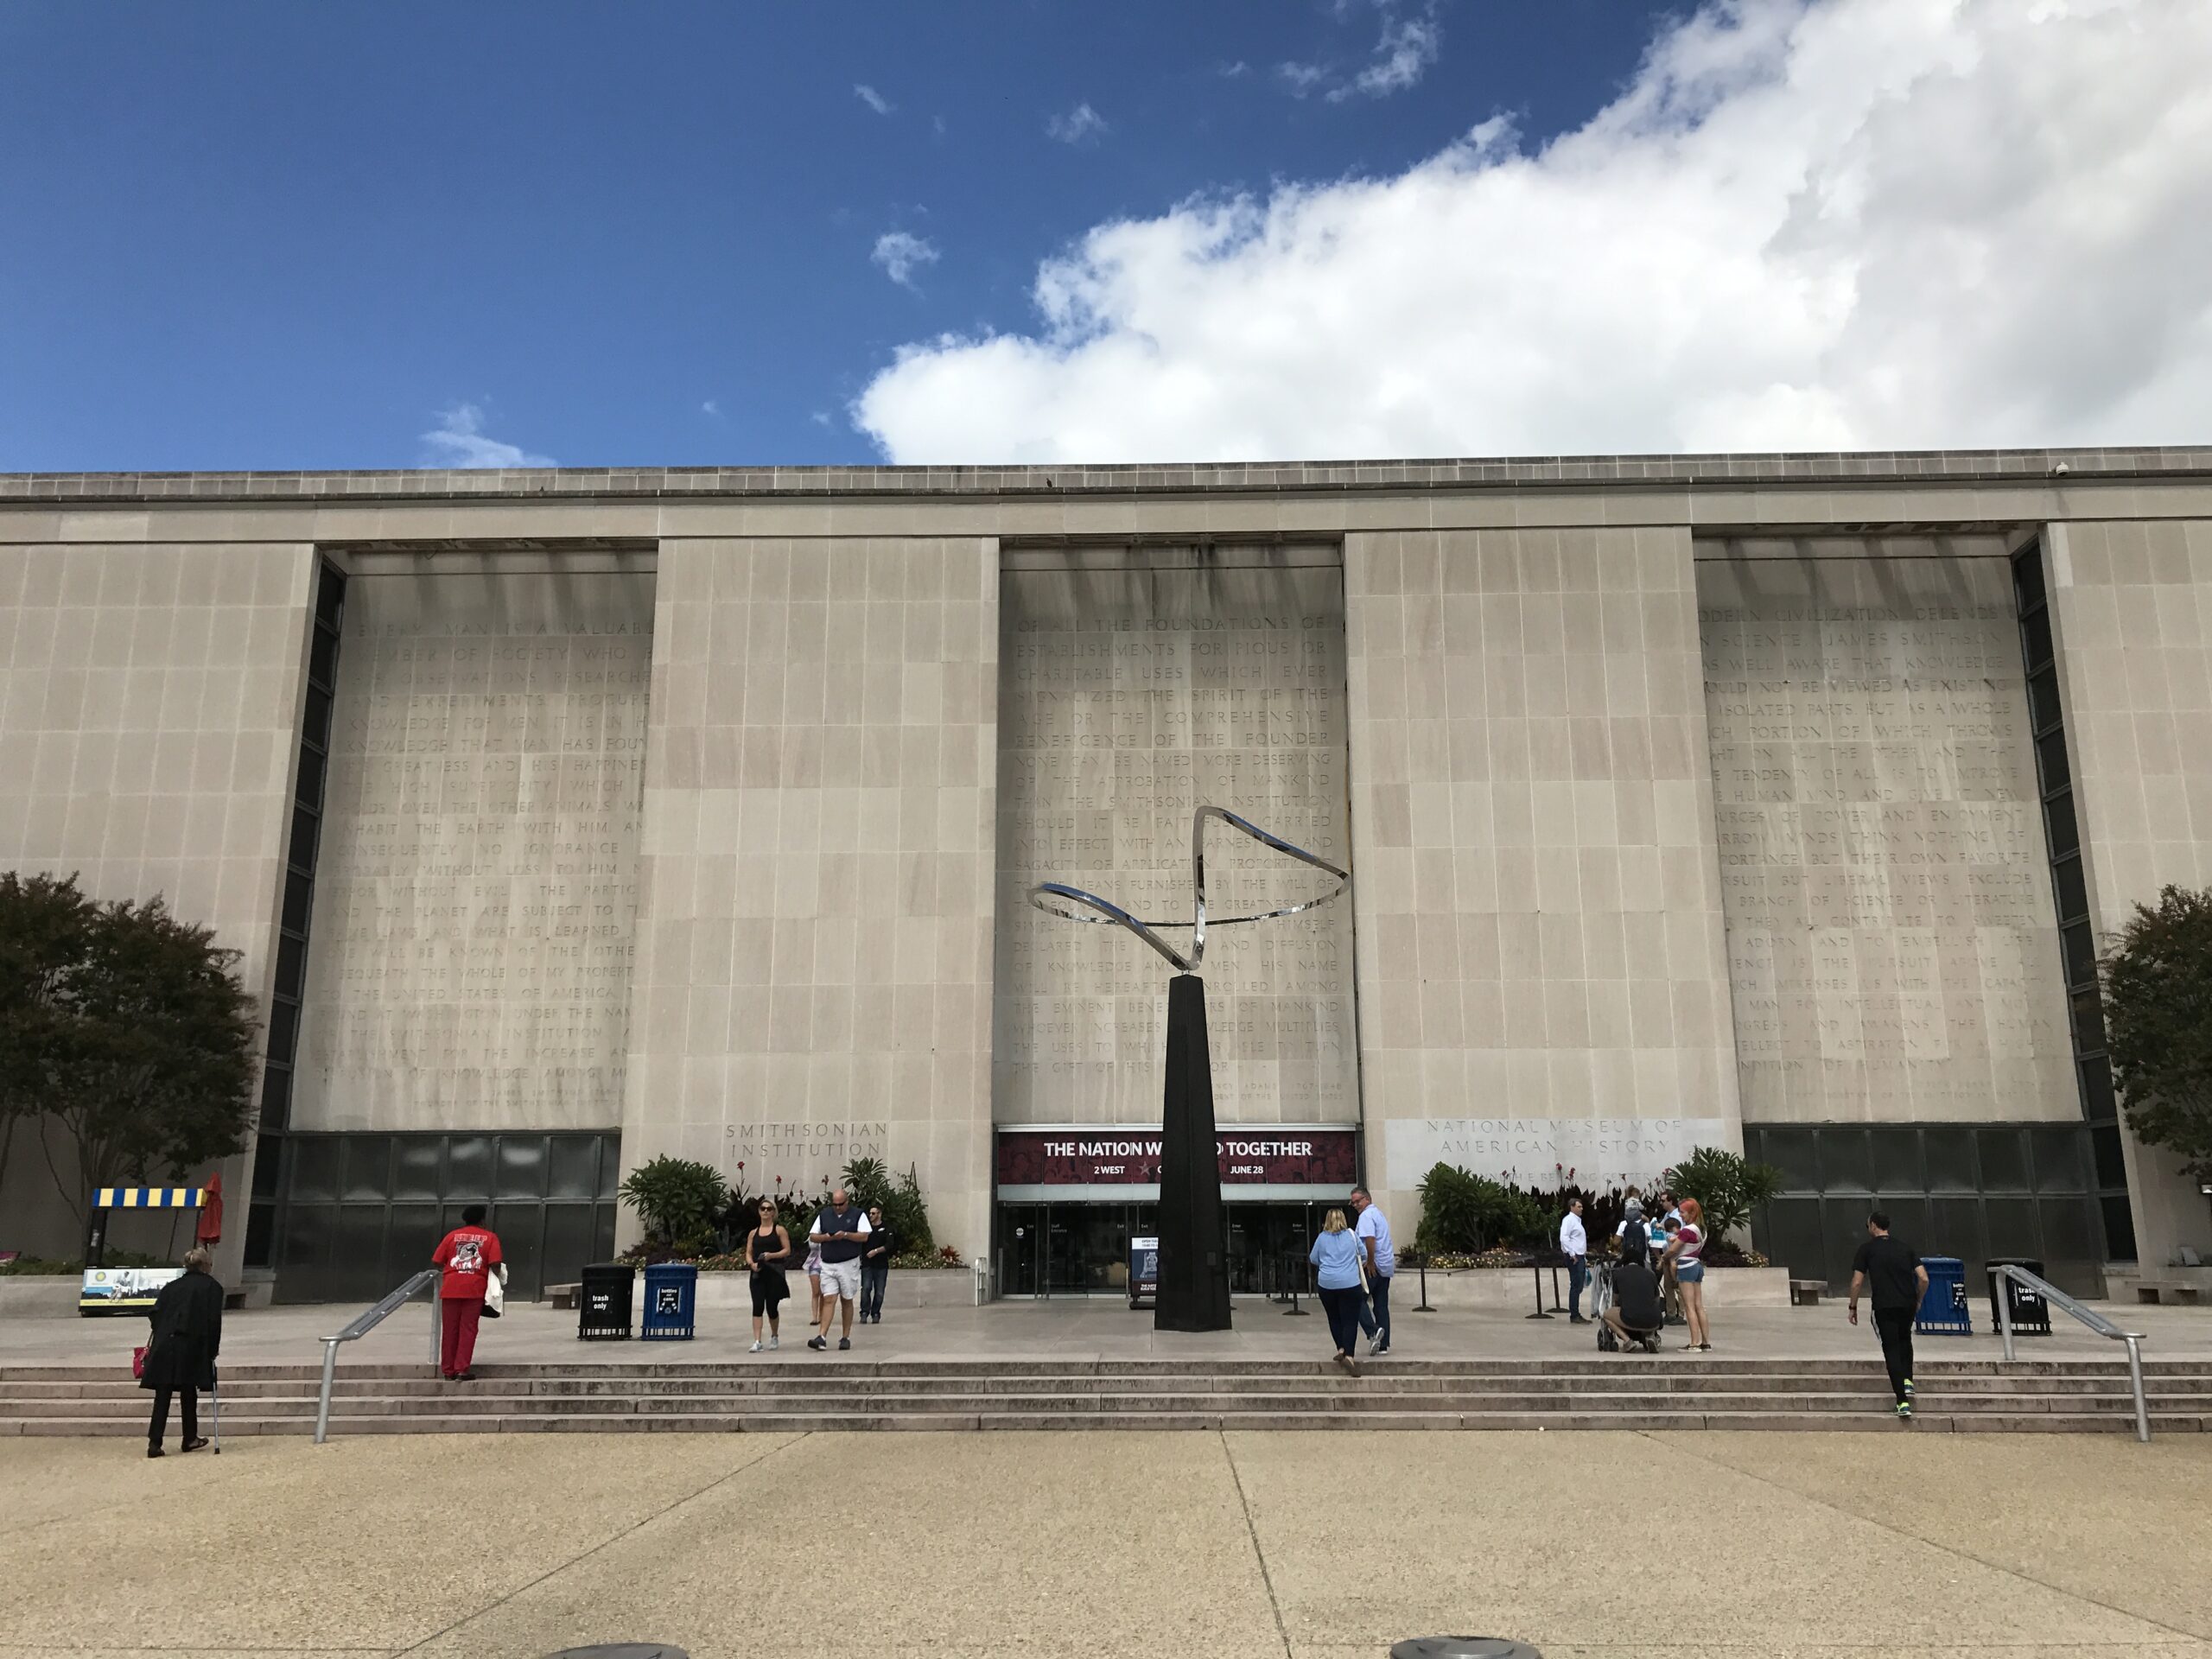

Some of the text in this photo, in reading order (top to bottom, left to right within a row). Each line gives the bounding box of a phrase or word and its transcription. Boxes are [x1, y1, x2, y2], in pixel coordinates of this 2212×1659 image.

[1776, 607, 1999, 621] CIVILIZATION DEPENDS
[1054, 617, 1325, 632] ALL THE FOUNDATIONS OF
[1827, 632, 2001, 646] JAMES SMITHSON
[454, 649, 477, 660] OF
[583, 648, 626, 658] WHO
[1017, 641, 1326, 658] ESTABLISHMENTS FOR PIOUS OR
[1730, 657, 2004, 671] WELL AWARE THAT KNOWLEDGE
[1018, 665, 1326, 681] CHARITABLE USES WHICH EVER
[1802, 678, 2007, 693] BE VIEWED AS EXISTING
[1016, 688, 1327, 702] SIGNALIZED THE SPIRIT OF THE
[1720, 702, 2011, 717] ISOLATED WHOLE
[1074, 710, 1328, 726] OR THE COMPREHENSIVE
[1750, 724, 2012, 739] PORTION OF THROWS
[563, 738, 594, 750] HAS
[1016, 732, 1328, 747] BENEFICENCE OF THE FOUNDER
[1016, 753, 1332, 767] NONE CAN BE NAMED DESERVING
[1109, 796, 1212, 808] SMITHSONIAN
[416, 823, 441, 835] THE
[458, 823, 505, 835] EARTH
[524, 822, 561, 834] WITH
[1015, 816, 1332, 830] SHOULD IT BE CARRIED
[1059, 838, 1109, 850] EFFECT
[1120, 838, 1154, 849] WITH
[1303, 836, 1332, 848] AND
[540, 885, 565, 896] THE
[1243, 878, 1334, 889] THE WILL OF
[480, 906, 509, 917] ARE
[1162, 899, 1179, 910] TO
[1277, 918, 1335, 930] HIMSELF
[1014, 940, 1249, 951] DECLARED AND
[1047, 960, 1338, 972] KNOWLEDGE HIS NAME
[1286, 981, 1338, 992] AMONG
[1053, 1001, 1114, 1014] EMINENT
[1271, 1001, 1338, 1013] MANKIND
[1096, 1042, 1111, 1052] TO
[1127, 1062, 1150, 1072] HIS
[726, 1122, 887, 1138] SMITHSONIAN
[1427, 1120, 1681, 1134] NATIONAL MUSEUM OF
[732, 1142, 880, 1157] INSTITUTION
[1044, 1141, 1076, 1156] THE
[1078, 1141, 1142, 1156] NATION
[1225, 1141, 1313, 1156] TOGETHER
[1440, 1140, 1669, 1154] AMERICAN HISTORY
[1094, 1166, 1126, 1174] 2 WEST
[1230, 1166, 1264, 1174] JUNE 28
[2021, 1294, 2036, 1303] only
[594, 1302, 607, 1311] only
